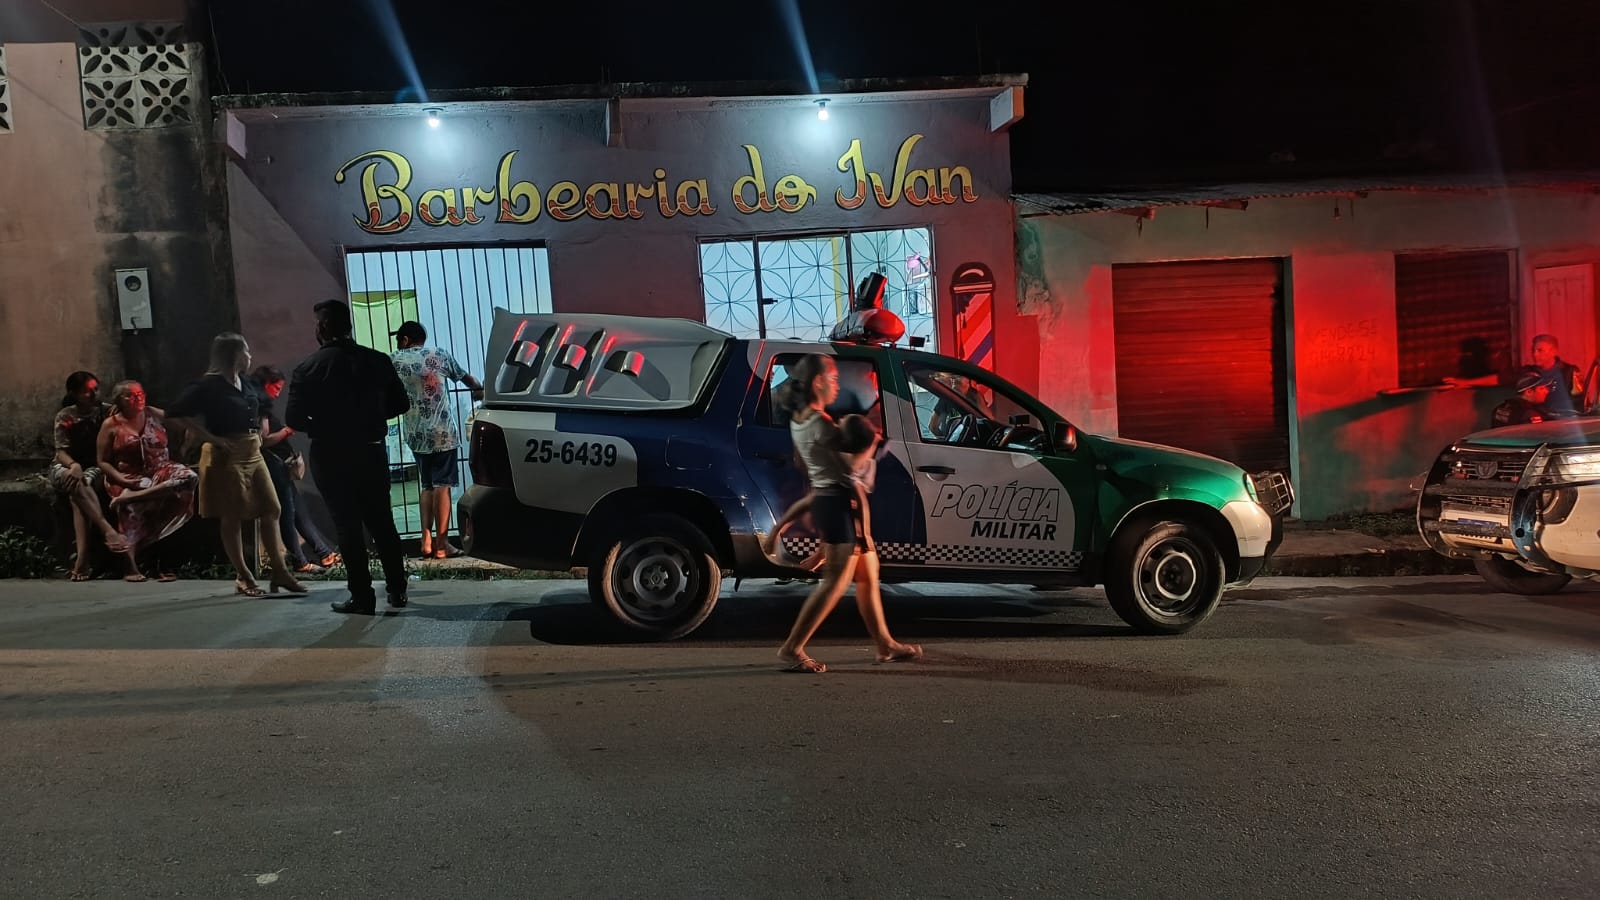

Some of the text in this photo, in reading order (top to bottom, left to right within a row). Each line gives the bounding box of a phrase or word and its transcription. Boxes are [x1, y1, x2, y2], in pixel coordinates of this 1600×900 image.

[334, 149, 717, 235] Barbearia
[731, 144, 817, 214] do
[524, 438, 618, 467] 25-6439
[930, 480, 1060, 523] POLÍCIA
[970, 520, 1057, 541] MILITAR
